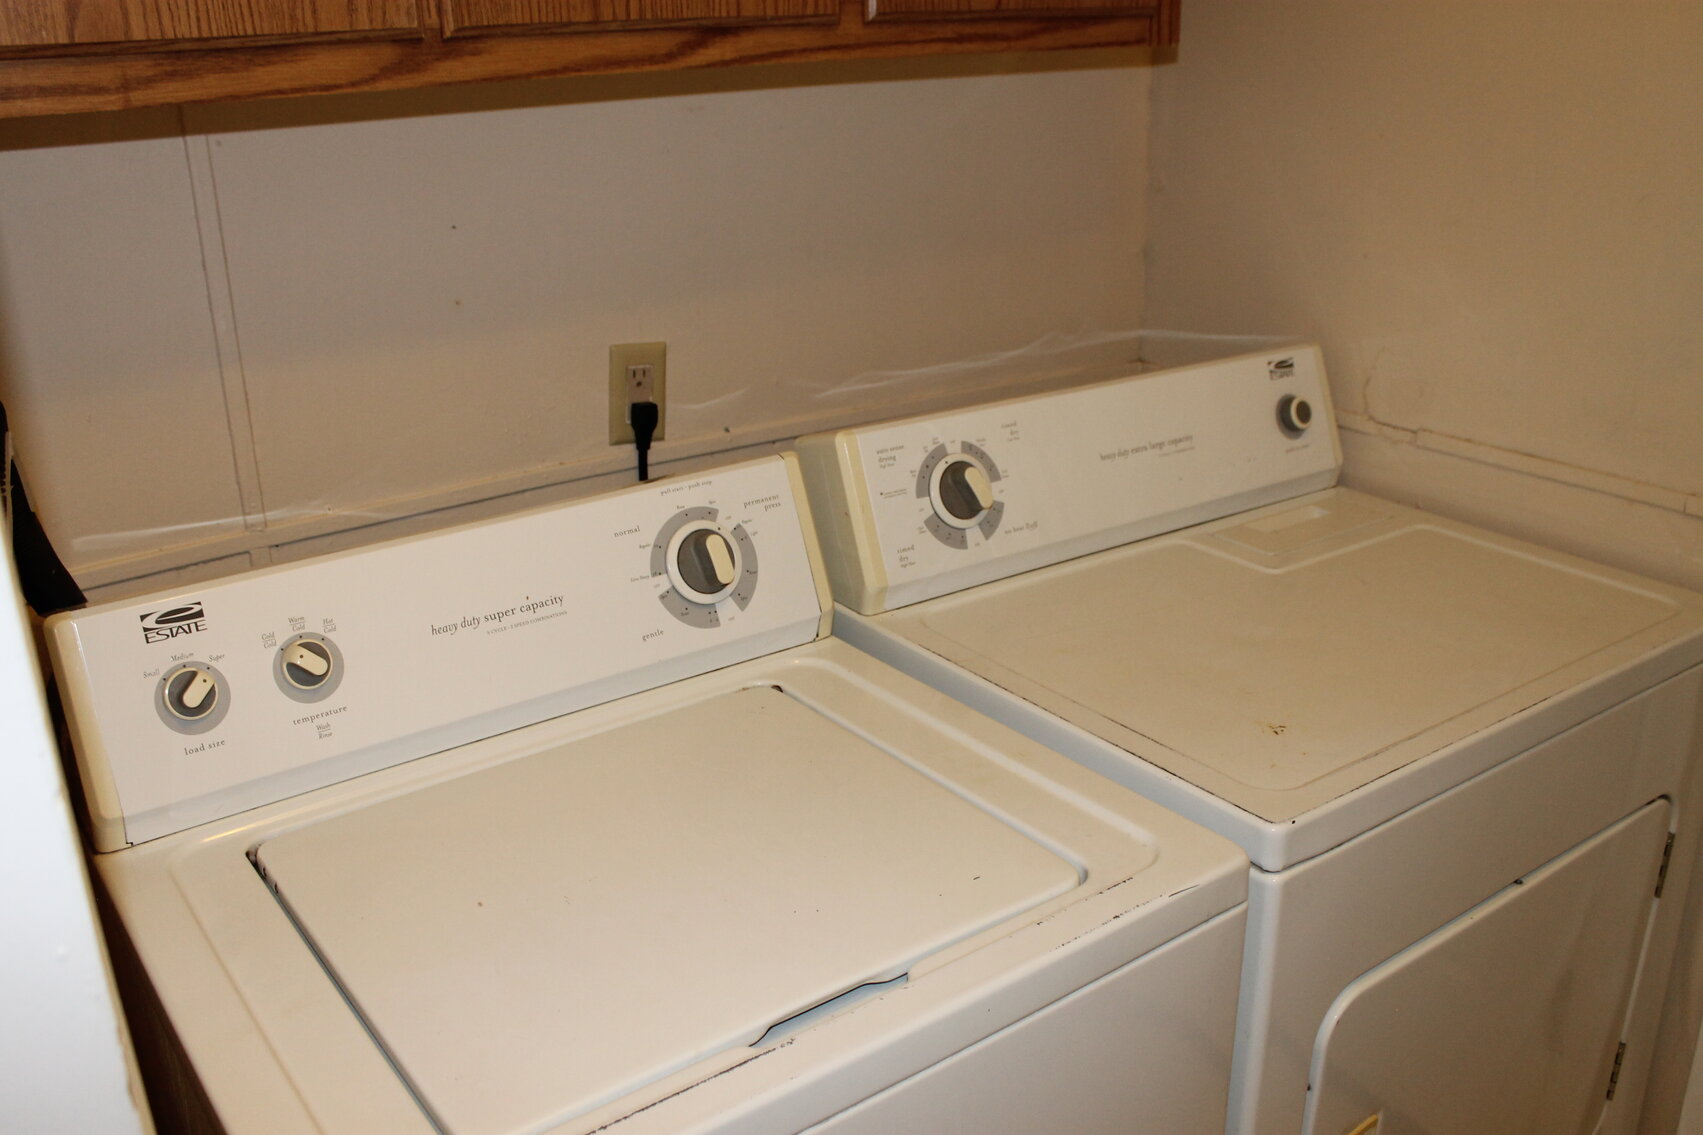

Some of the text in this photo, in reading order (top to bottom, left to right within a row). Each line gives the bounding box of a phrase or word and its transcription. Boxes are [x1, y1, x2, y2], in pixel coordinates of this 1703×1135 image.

[660, 488, 671, 496] pull
[688, 482, 700, 491] push
[743, 494, 780, 509] permanent
[764, 502, 782, 512] press
[614, 525, 641, 538] normal
[288, 616, 305, 625] Warm
[431, 595, 564, 636] heavy duty super capacity
[322, 617, 334, 626] Hot
[144, 619, 208, 644] ESTATE
[292, 623, 306, 633] Cold
[323, 625, 337, 634] Cold
[261, 631, 275, 641] Cold
[641, 628, 664, 643] gentle
[263, 640, 277, 649] Cold
[170, 652, 195, 663] Medium
[208, 653, 226, 664] Super
[143, 668, 160, 679] Small
[292, 705, 348, 726] temperature
[316, 722, 331, 732] Wash
[184, 739, 226, 756] load size
